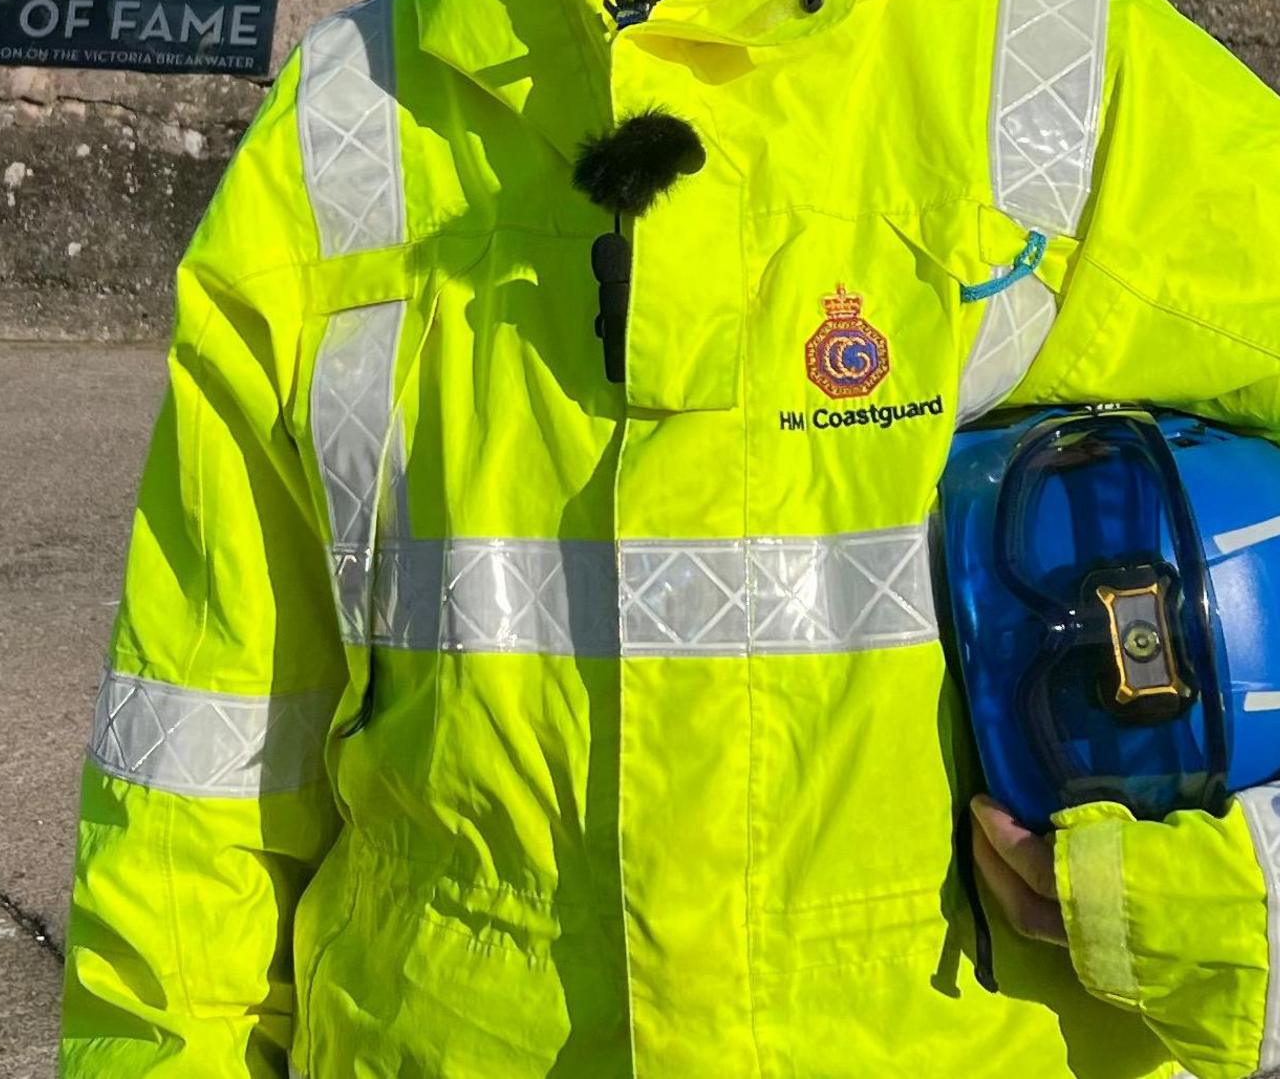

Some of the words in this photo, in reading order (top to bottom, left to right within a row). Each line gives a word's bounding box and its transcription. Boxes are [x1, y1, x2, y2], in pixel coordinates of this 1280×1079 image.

[109, 0, 262, 46] FAME
[26, 47, 49, 61] ON
[52, 49, 80, 62] THE
[84, 49, 155, 65] VICTORIA
[156, 52, 255, 69] BREAKWATER
[779, 410, 806, 431] HM
[812, 395, 943, 428] Coastguard
